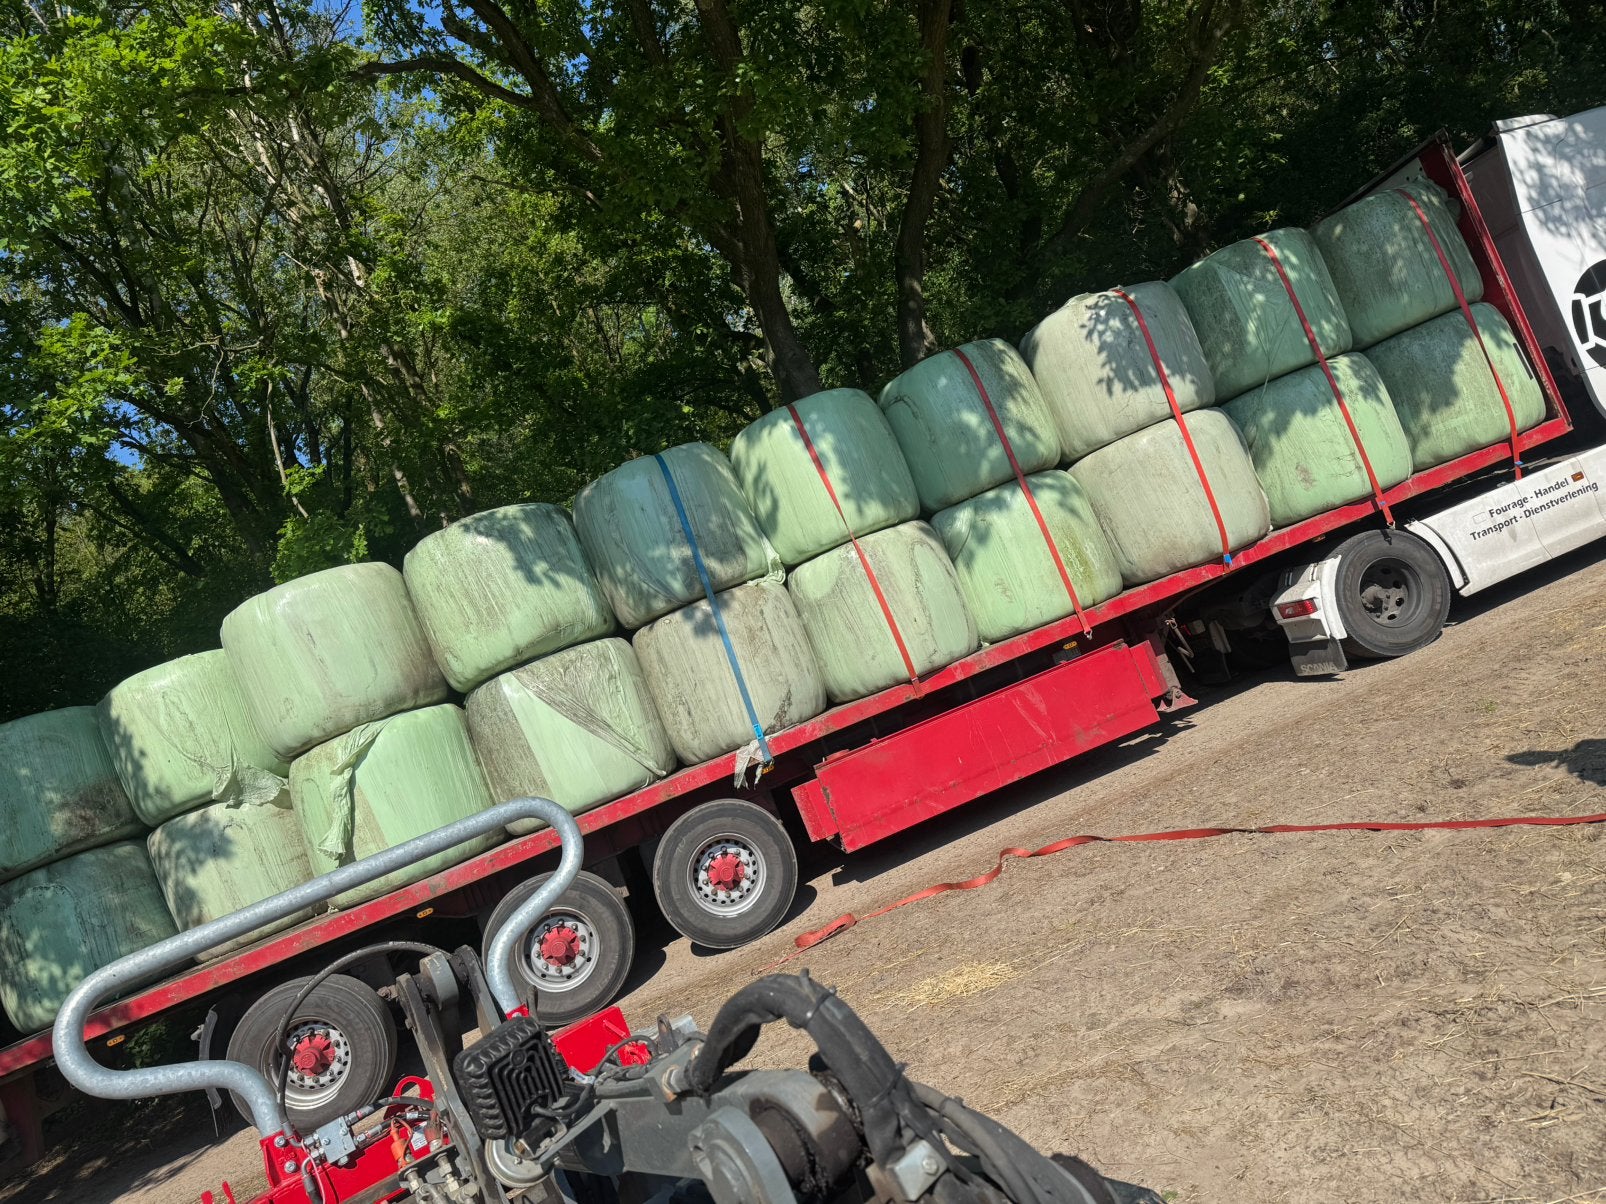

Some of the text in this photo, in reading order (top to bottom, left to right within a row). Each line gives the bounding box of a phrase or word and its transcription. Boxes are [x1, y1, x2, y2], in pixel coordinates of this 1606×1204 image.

[1470, 515, 1519, 541] Transport
[1523, 481, 1599, 518] Dienstverlening
[1488, 496, 1529, 518] Fourage
[1534, 477, 1569, 499] Handel
[1300, 661, 1338, 674] SCANIA
